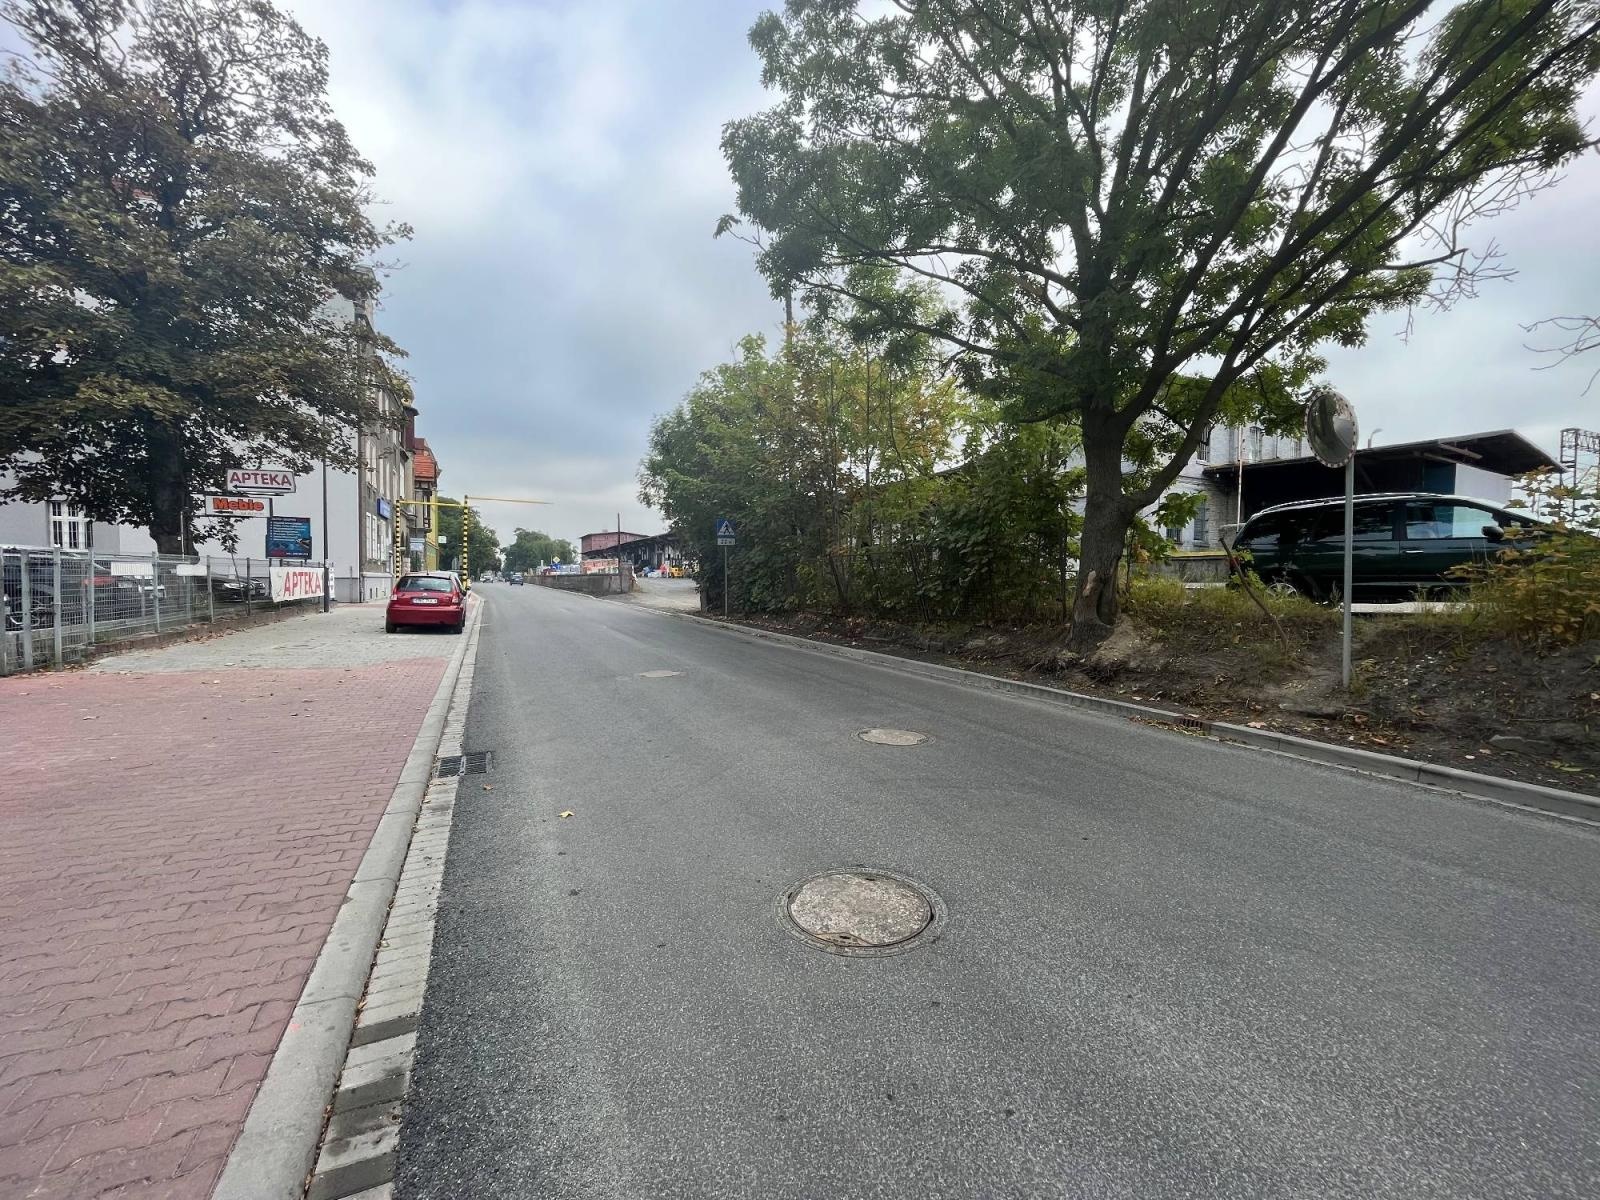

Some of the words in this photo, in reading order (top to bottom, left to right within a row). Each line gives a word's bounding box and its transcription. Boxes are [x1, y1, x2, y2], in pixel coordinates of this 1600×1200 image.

[230, 471, 292, 486] APTEKA
[213, 498, 264, 511] Meble
[284, 571, 321, 596] APTEKA
